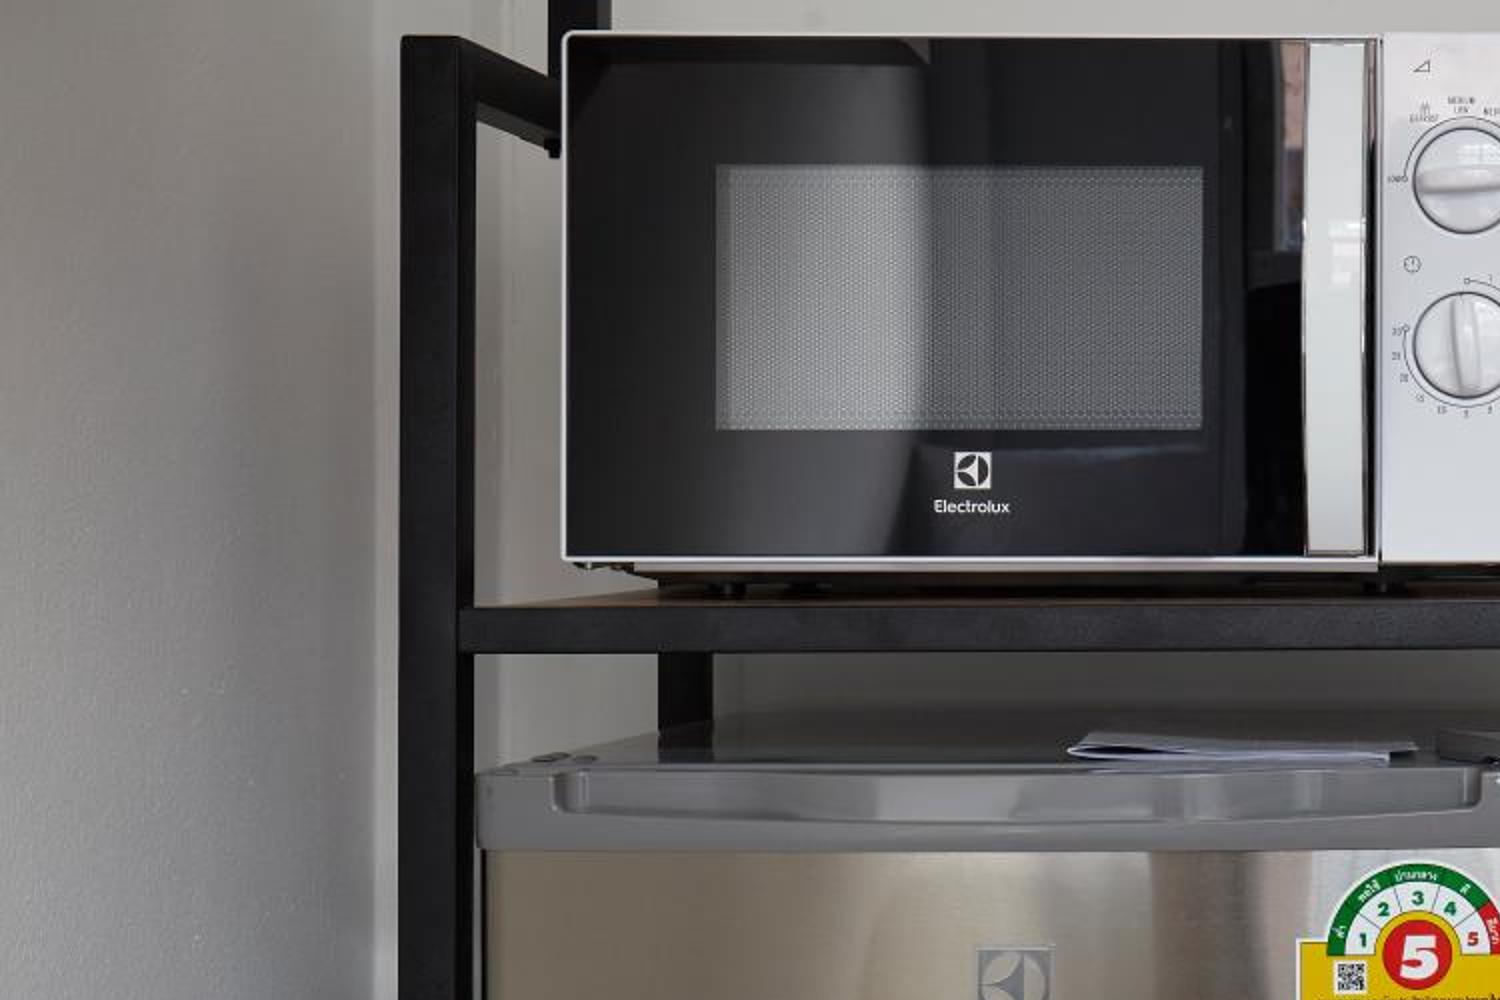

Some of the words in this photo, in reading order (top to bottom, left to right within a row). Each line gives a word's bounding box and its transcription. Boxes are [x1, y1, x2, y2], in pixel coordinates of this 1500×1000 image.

[934, 499, 1009, 513] Electrolux
[1412, 891, 1424, 905] 3
[1378, 903, 1390, 917] 2
[1444, 901, 1457, 915] 4
[1359, 933, 1366, 947] 1
[1467, 932, 1479, 946] 5
[1400, 935, 1440, 980] 5
